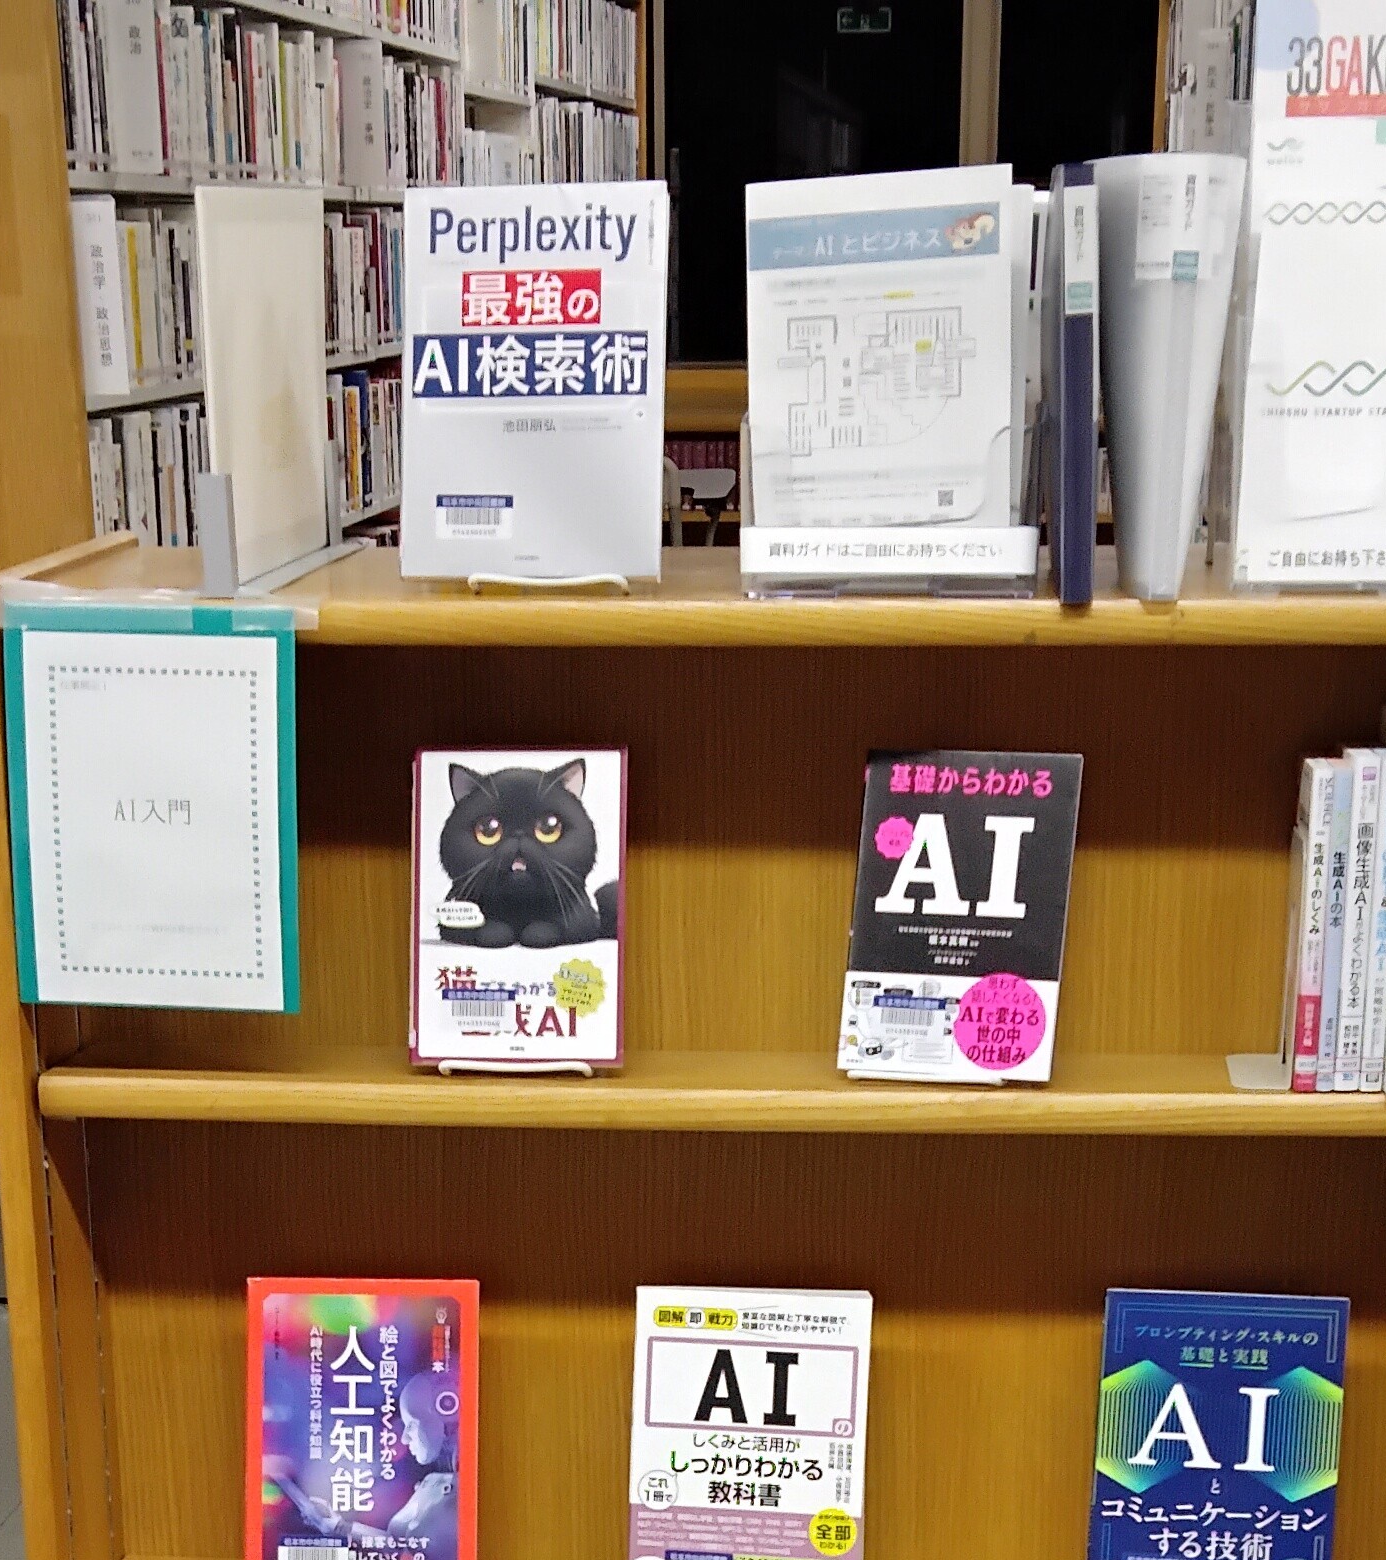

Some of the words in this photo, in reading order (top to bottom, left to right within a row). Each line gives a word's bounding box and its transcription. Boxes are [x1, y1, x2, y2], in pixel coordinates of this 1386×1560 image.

[429, 203, 637, 264] Perplexity
[463, 272, 600, 326] 最強の
[414, 333, 648, 396] AI検索術
[768, 542, 1003, 558] 資料ガイドはご自由にお持ちください
[889, 763, 1053, 798] 基礎からわかる
[114, 798, 192, 826] AI入門
[874, 812, 1036, 919] AI
[1329, 851, 1347, 928] 生成AIの本
[960, 1006, 1040, 1026] AIで変わる
[976, 1026, 1021, 1044] 世の中
[966, 1045, 1027, 1064] の仕組み
[1134, 1325, 1320, 1346] プロンプティング・スキルの
[1179, 1346, 1269, 1366] 基礎と実践
[693, 1348, 800, 1427] AI
[379, 1325, 400, 1481] 絵と図でよくわかる
[330, 1325, 376, 1512] 人工知能
[1127, 1382, 1281, 1472] AI
[693, 1433, 801, 1454] しくみと活用が
[670, 1450, 824, 1482] しっかりわかる
[647, 1477, 669, 1489] これ
[707, 1481, 782, 1508] 教科書
[1210, 1478, 1221, 1494] と
[1101, 1496, 1328, 1532] コミュニケーション
[816, 1524, 851, 1542] 全部
